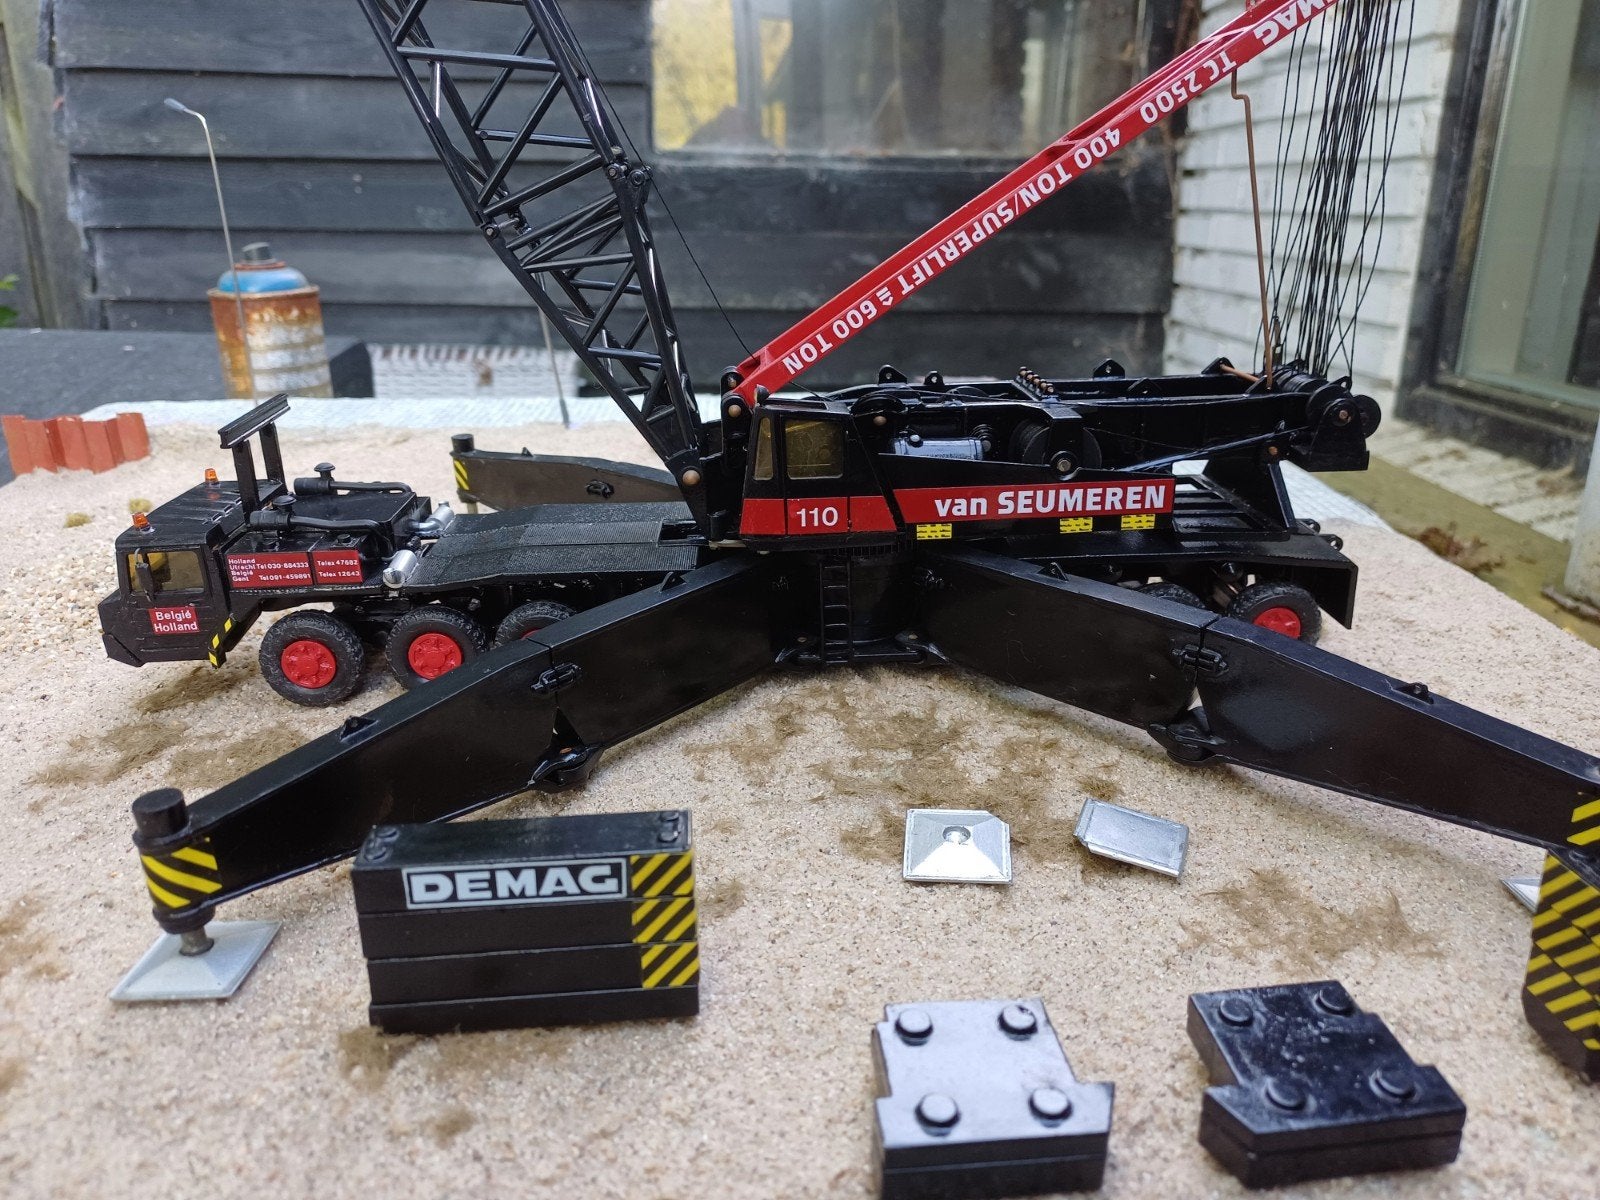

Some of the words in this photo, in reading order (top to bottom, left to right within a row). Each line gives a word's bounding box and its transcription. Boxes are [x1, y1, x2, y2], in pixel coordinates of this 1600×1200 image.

[1253, 0, 1333, 46] MAG
[1203, 50, 1237, 81] TC
[1140, 72, 1203, 124] 2500
[1074, 127, 1121, 170] 400
[832, 301, 878, 339] 600
[782, 333, 833, 375] TON
[796, 506, 838, 528] 110
[934, 496, 987, 517] van
[996, 485, 1166, 515] SEUMEREN
[153, 621, 198, 632] Holland
[410, 865, 619, 903] DEMAG
